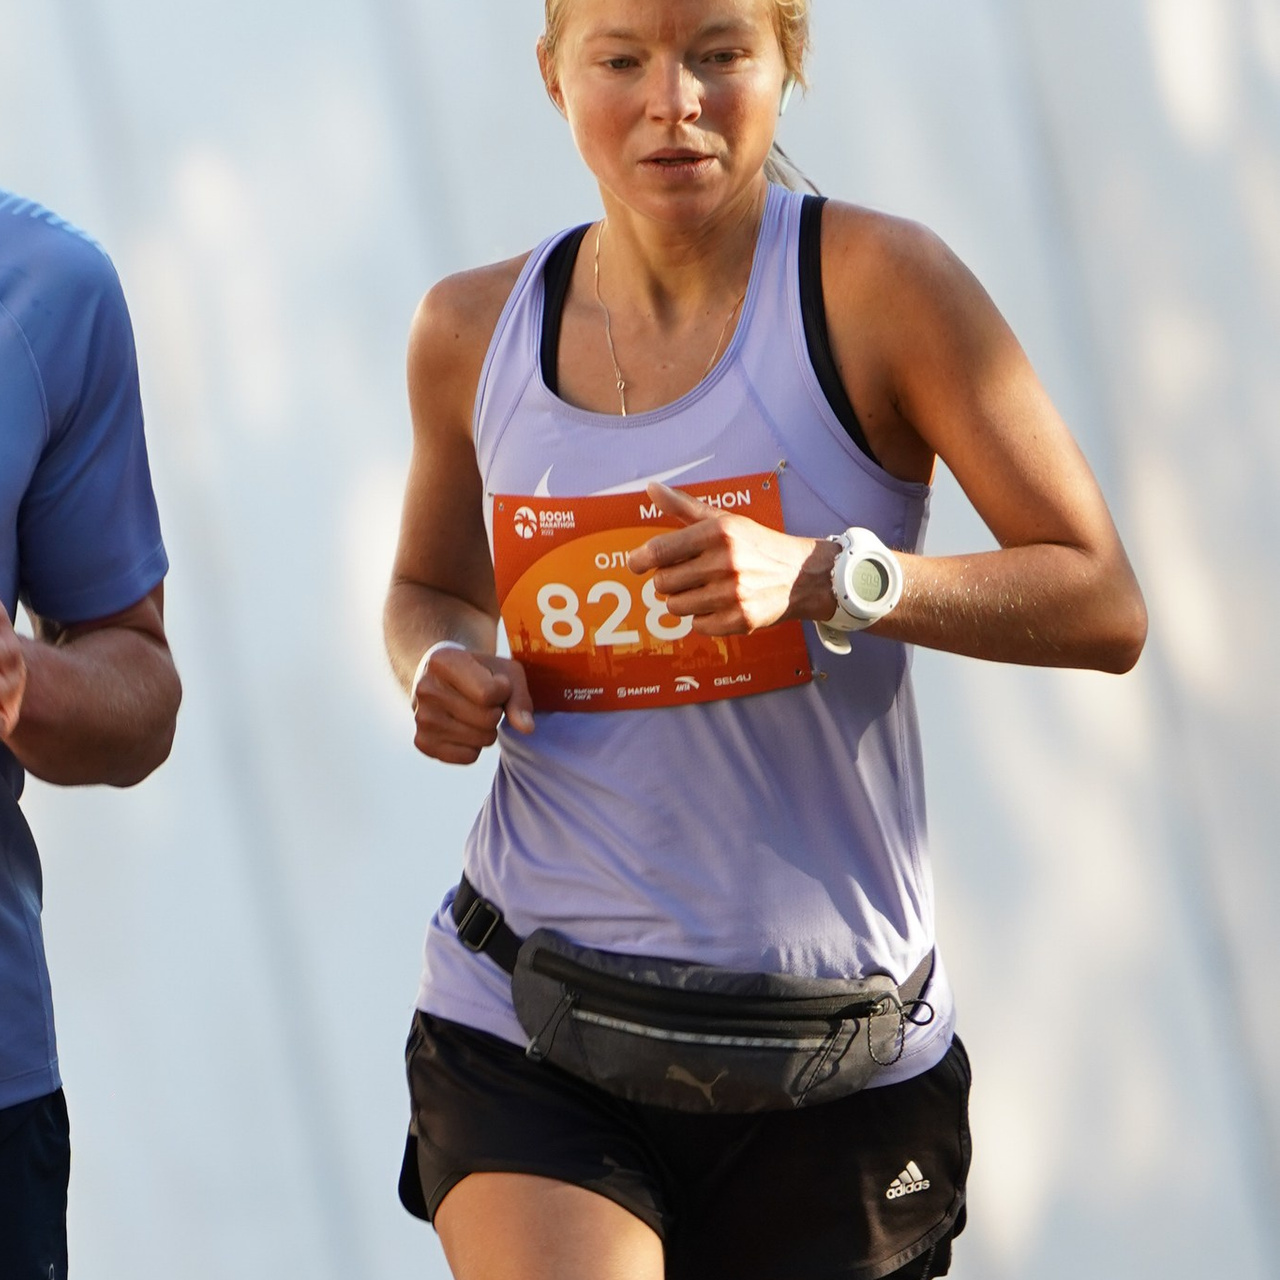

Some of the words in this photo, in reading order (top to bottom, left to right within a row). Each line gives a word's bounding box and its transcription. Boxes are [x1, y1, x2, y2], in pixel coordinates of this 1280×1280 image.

[639, 489, 751, 519] MTHON
[536, 580, 695, 649] 828
[714, 673, 752, 687] GEL4U
[627, 685, 660, 696] МАГНИТ
[886, 1180, 930, 1200] adidas
